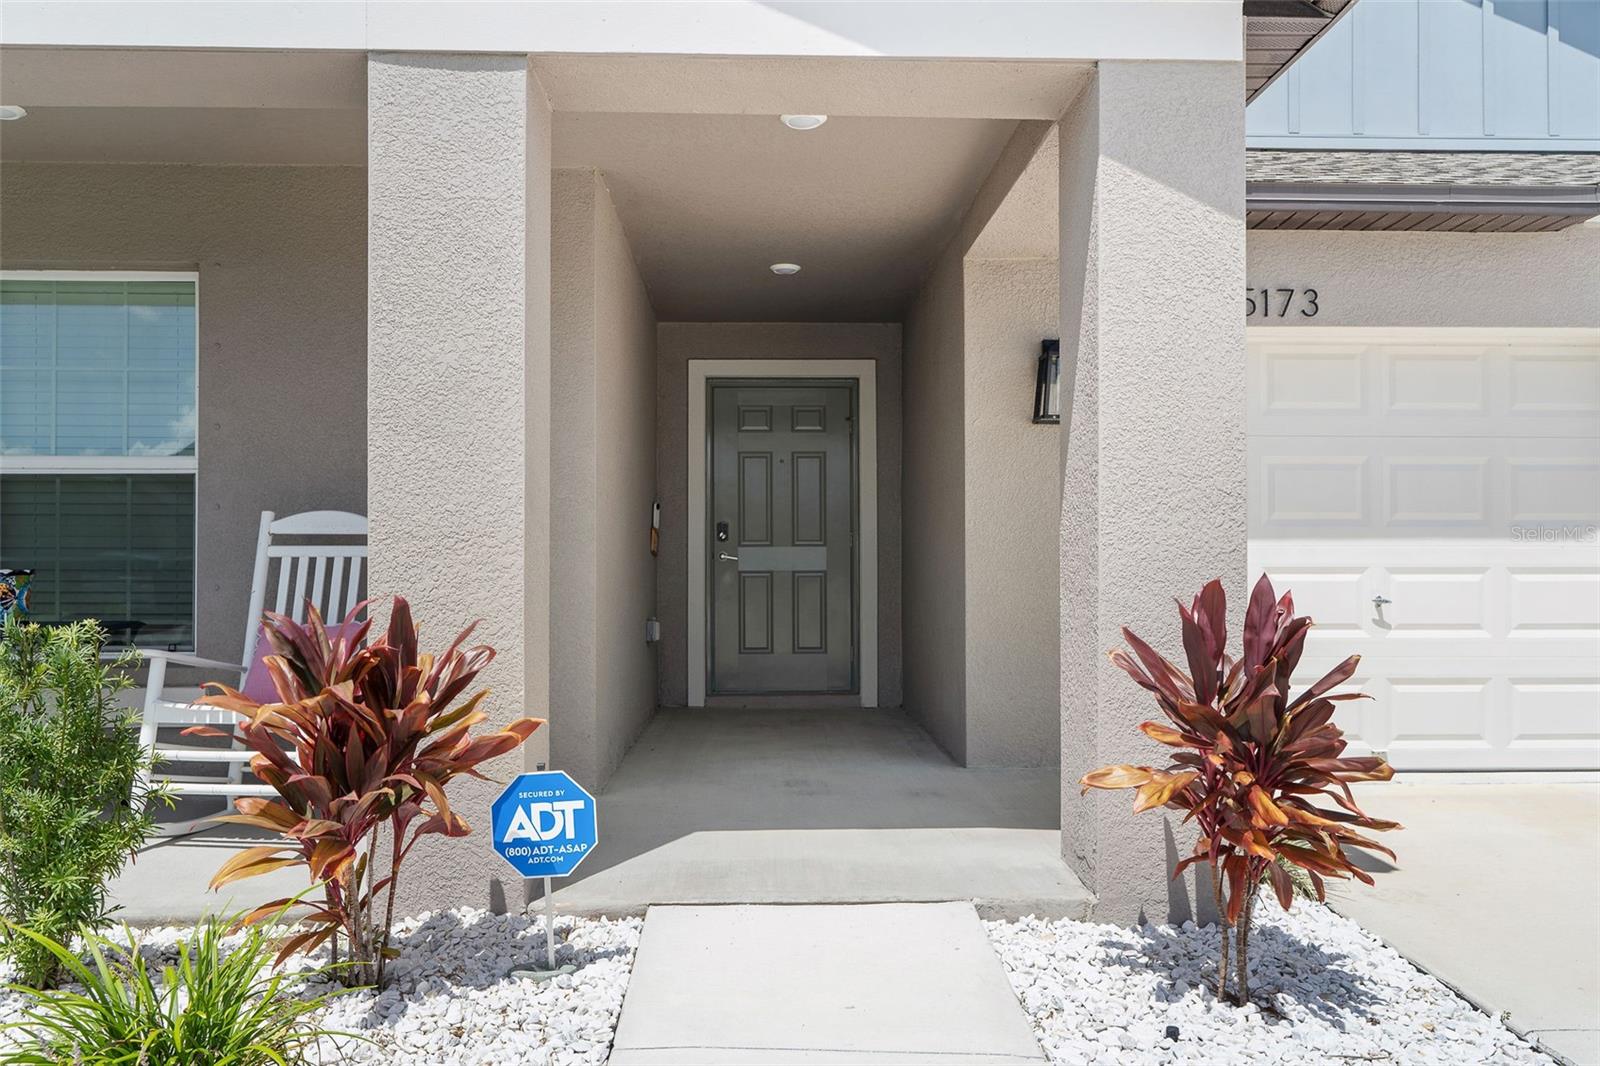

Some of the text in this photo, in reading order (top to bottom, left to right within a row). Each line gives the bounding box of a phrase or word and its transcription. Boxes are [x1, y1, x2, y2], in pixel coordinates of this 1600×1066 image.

[519, 791, 554, 799] SECURED
[503, 800, 585, 843] ADT
[505, 843, 588, 858] (800) ADT-ASAP
[528, 856, 564, 864] ADT.COM
